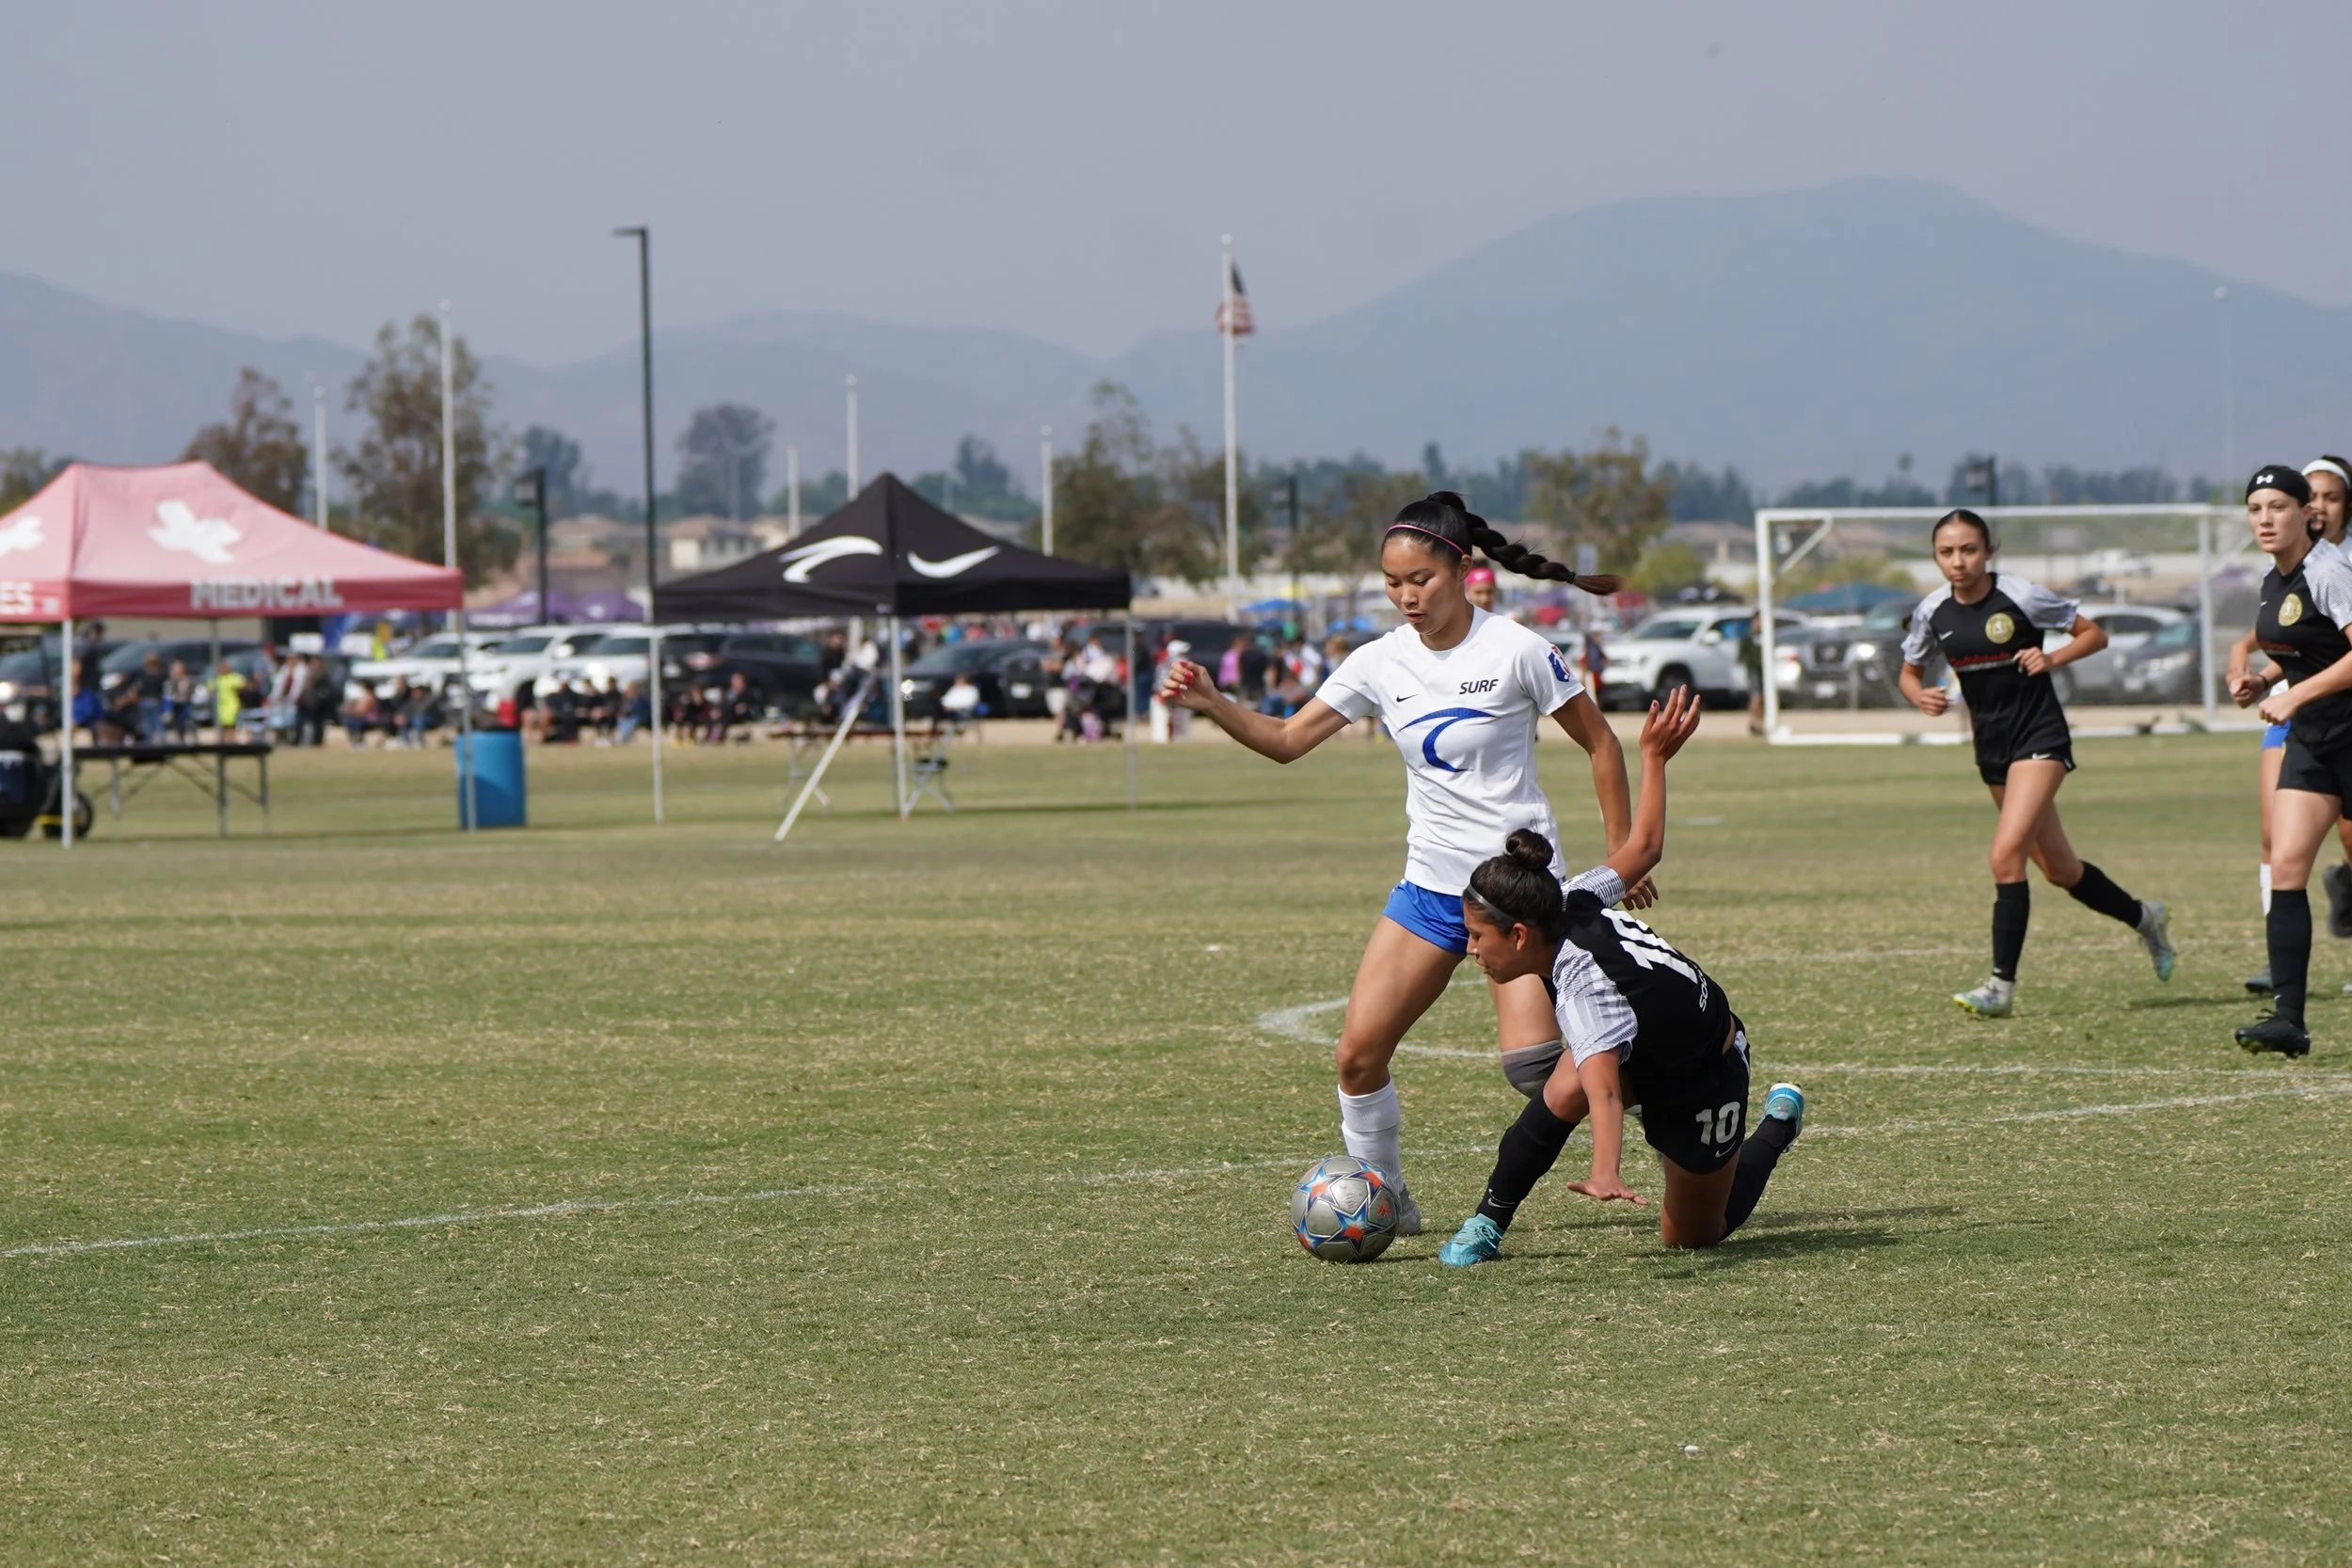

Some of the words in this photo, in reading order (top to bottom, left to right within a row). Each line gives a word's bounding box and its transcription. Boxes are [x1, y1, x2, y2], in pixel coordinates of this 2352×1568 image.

[191, 575, 344, 610] MEDICAL
[1459, 678, 1499, 695] SURF
[1695, 1101, 1740, 1146] 10
